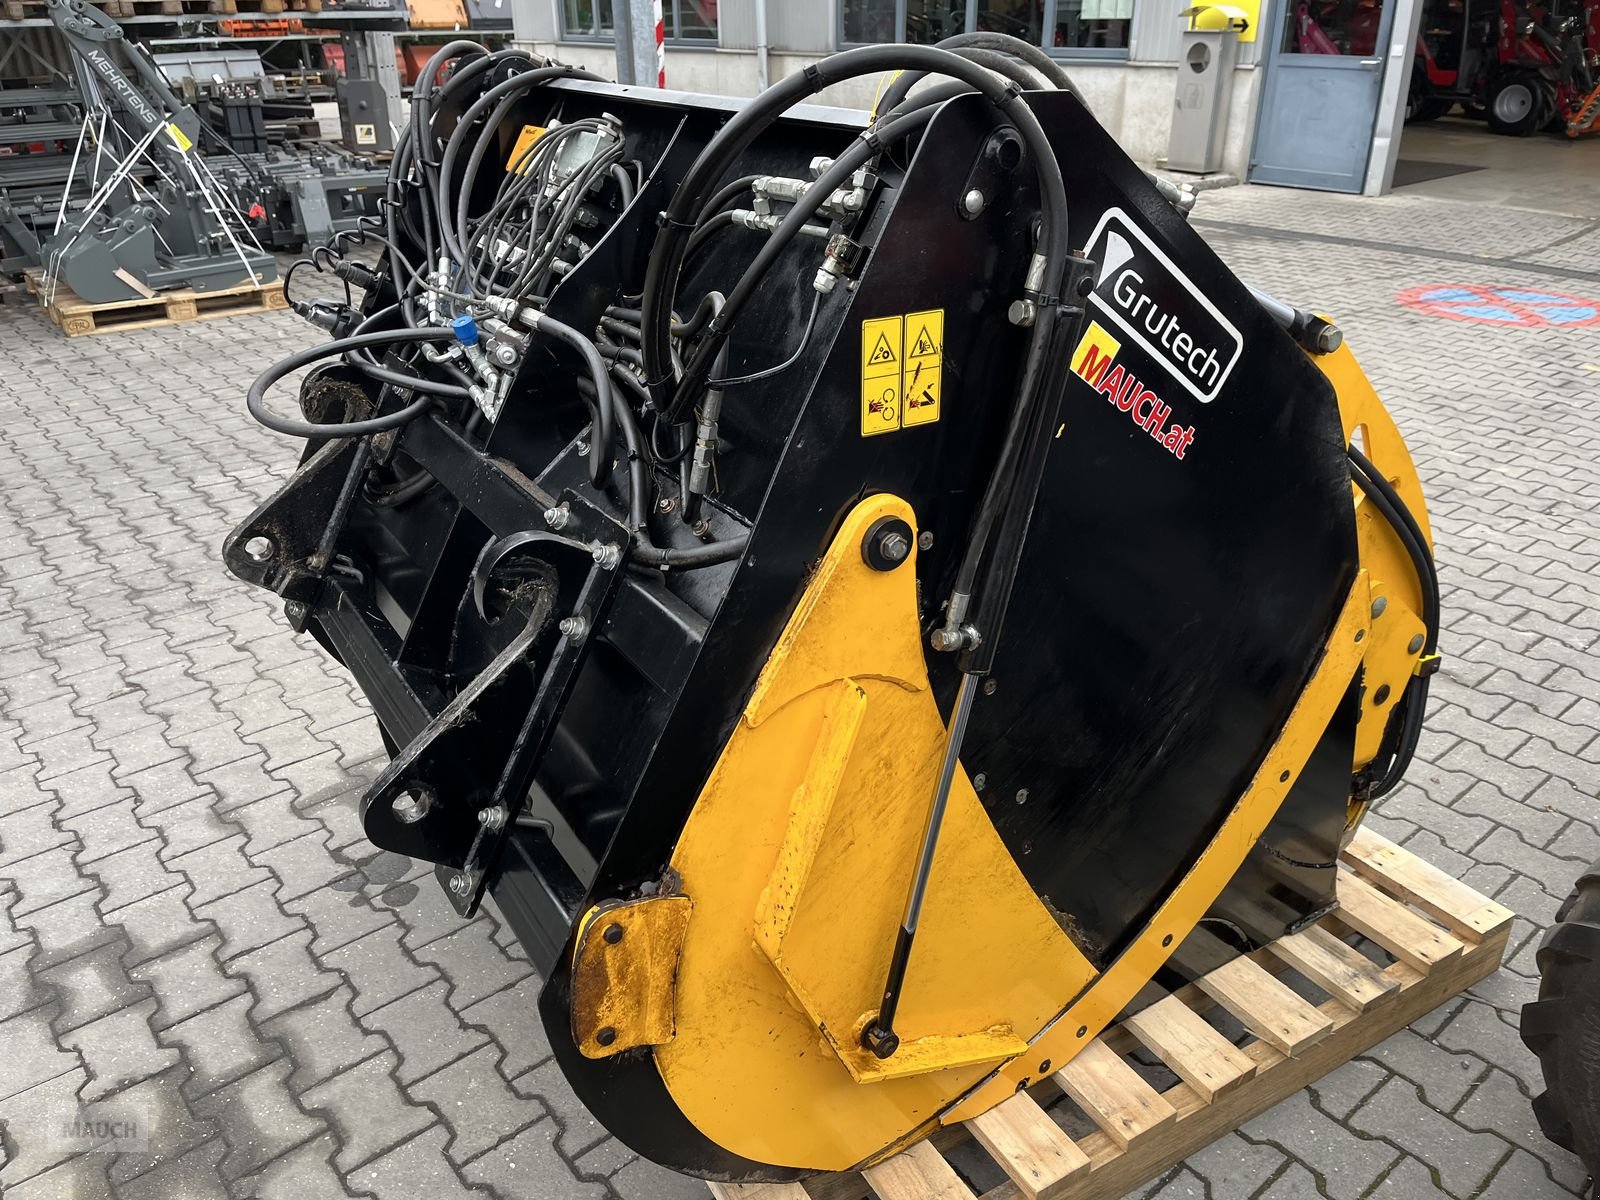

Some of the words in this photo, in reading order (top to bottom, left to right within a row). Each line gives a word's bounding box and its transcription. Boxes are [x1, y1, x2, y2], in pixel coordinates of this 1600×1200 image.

[88, 50, 157, 124] MEHRTENS
[1113, 269, 1220, 387] Grutech
[1077, 343, 1196, 460] MAUCH.at
